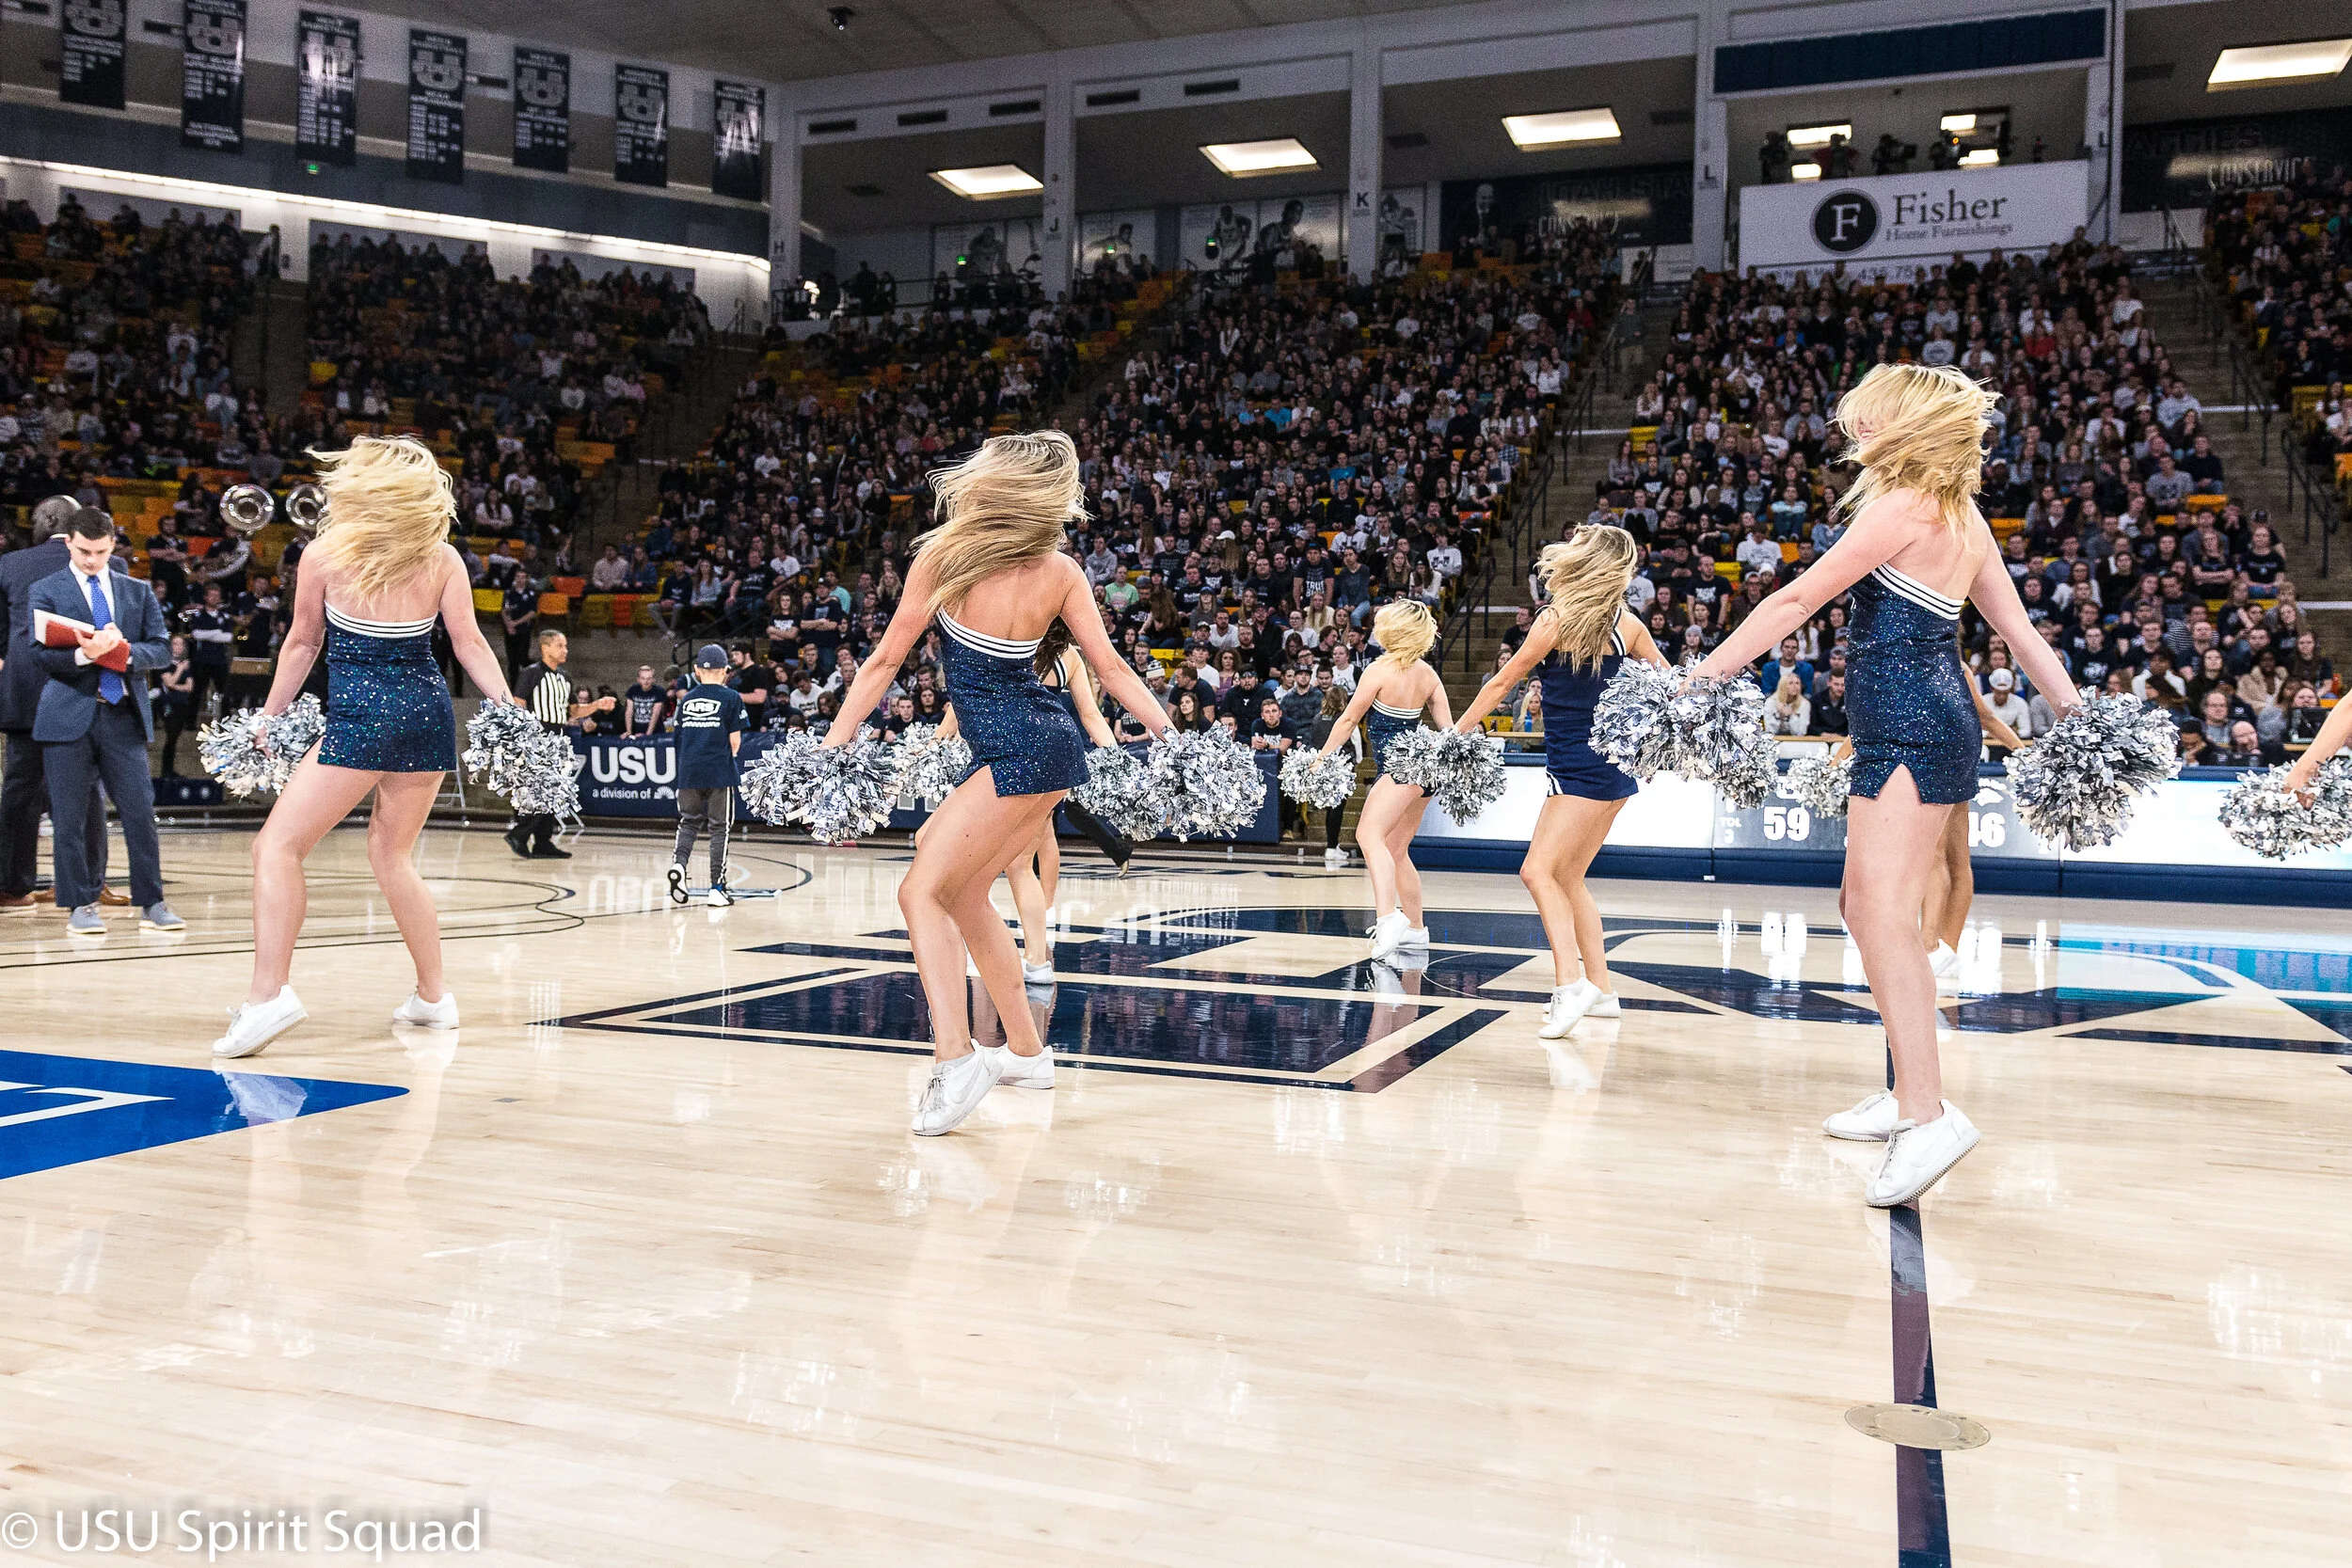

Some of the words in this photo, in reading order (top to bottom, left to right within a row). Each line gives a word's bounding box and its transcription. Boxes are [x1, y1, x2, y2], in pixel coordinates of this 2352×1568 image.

[1704, 165, 1716, 180] L
[1356, 192, 1369, 208] K
[1893, 188, 2008, 226] Fisher
[1049, 217, 1058, 232] J
[1830, 203, 1861, 242] F
[1885, 228, 1928, 241] Home
[1931, 222, 2013, 239] Furnishings
[773, 240, 785, 254] H
[686, 702, 715, 712] ARS
[591, 746, 676, 784] USU
[592, 789, 599, 798] a
[600, 786, 639, 800] division
[640, 787, 651, 800] of
[1763, 806, 1810, 842] 59
